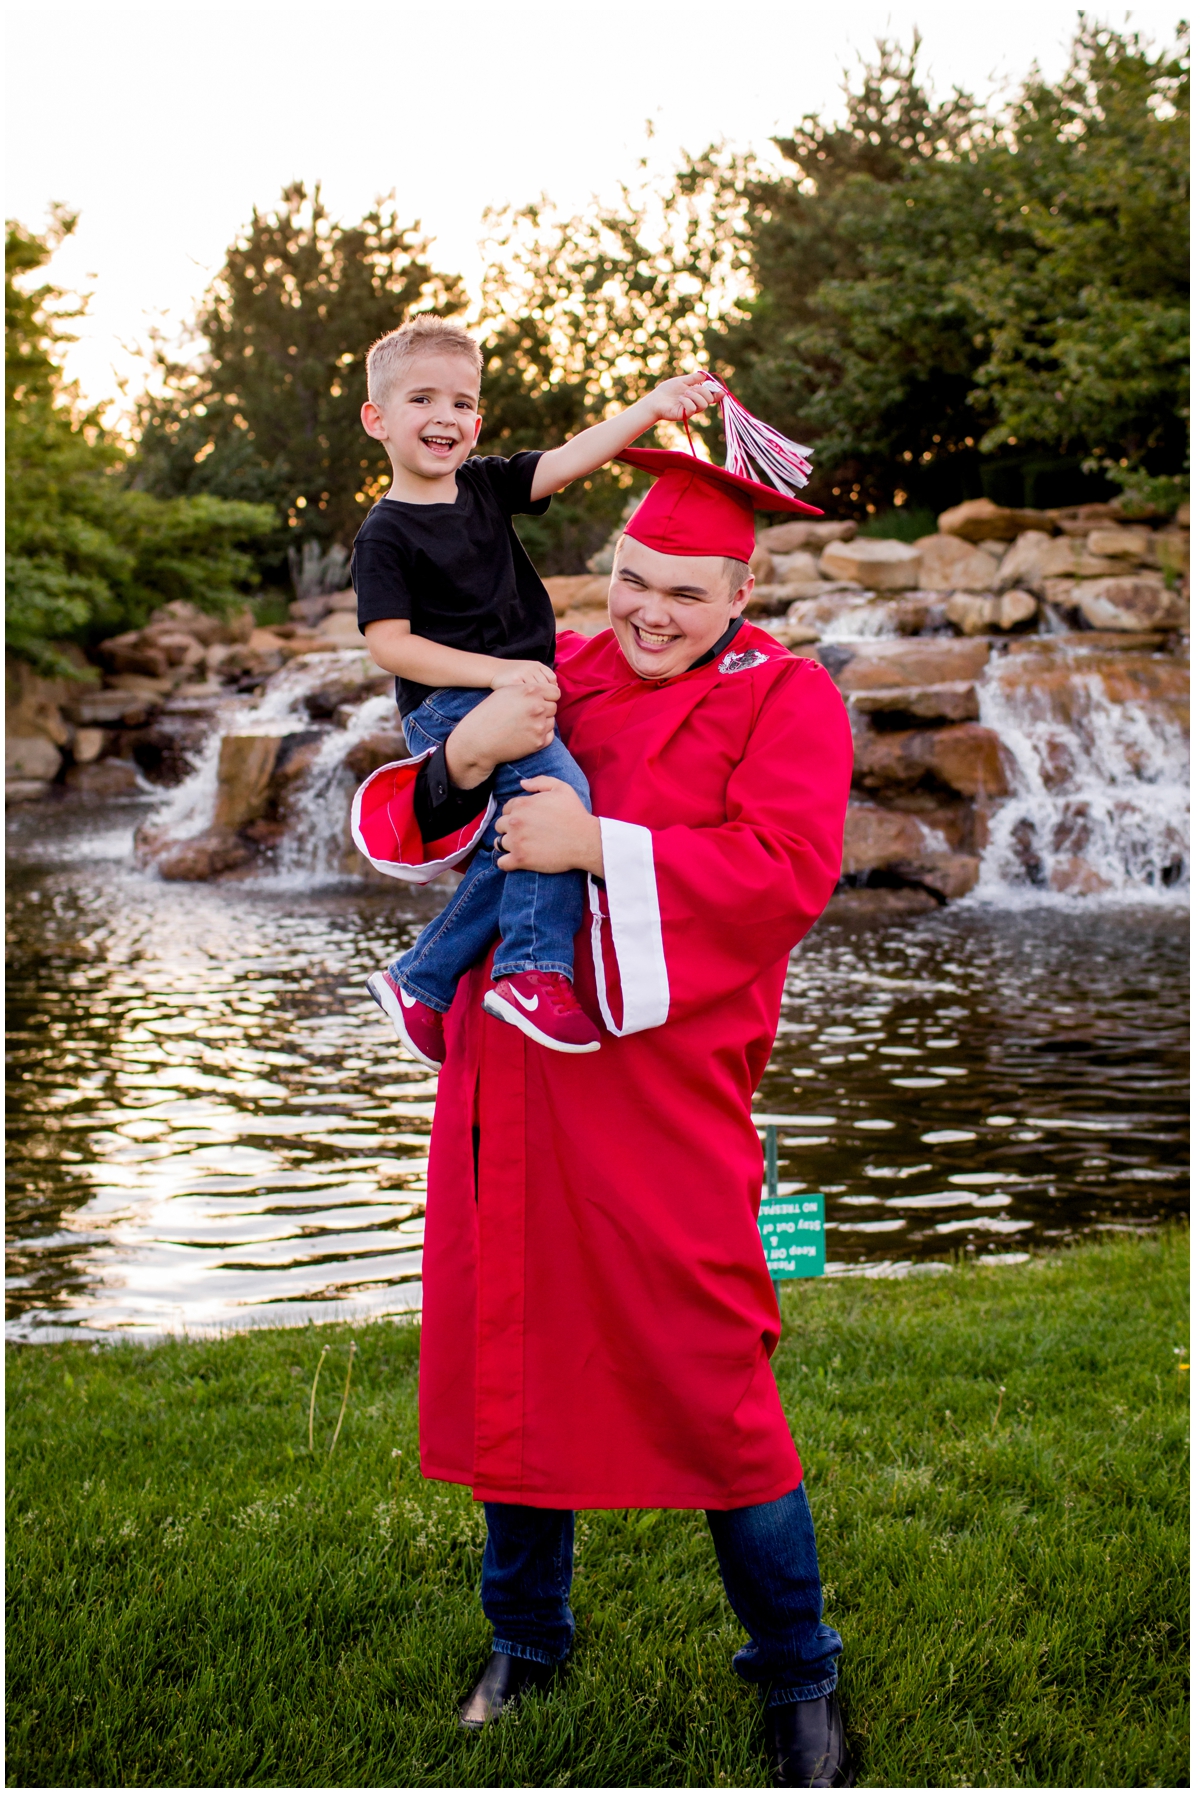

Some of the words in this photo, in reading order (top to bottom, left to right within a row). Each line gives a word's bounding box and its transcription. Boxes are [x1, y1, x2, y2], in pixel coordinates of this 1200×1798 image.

[802, 1203, 818, 1212] NO
[763, 1223, 774, 1235] of
[776, 1222, 795, 1233] Out
[797, 1219, 821, 1231] Stay
[770, 1236, 778, 1247] &
[770, 1248, 787, 1259] Off
[789, 1245, 816, 1256] Keep
